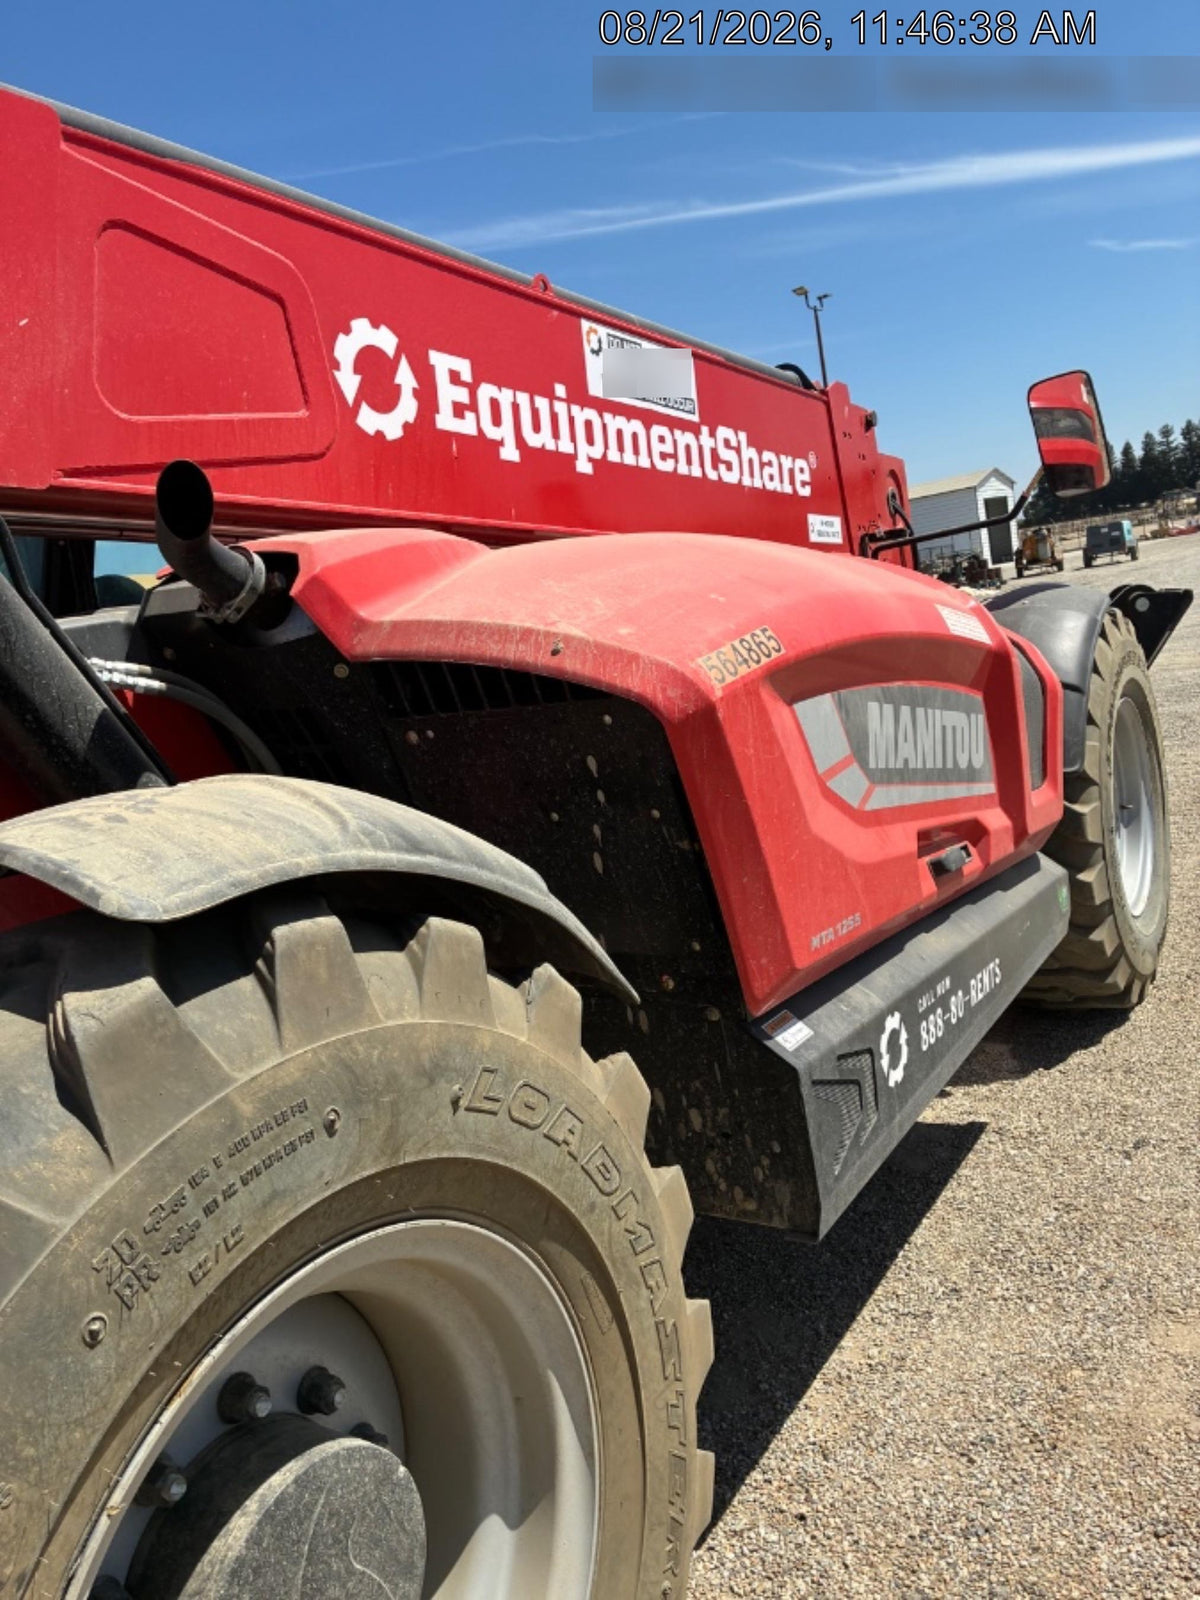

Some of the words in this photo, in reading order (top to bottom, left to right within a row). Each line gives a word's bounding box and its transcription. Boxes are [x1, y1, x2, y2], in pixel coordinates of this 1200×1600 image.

[428, 349, 812, 497] EquipmentShare
[701, 626, 782, 684] 564865
[867, 702, 985, 769] MANITOU
